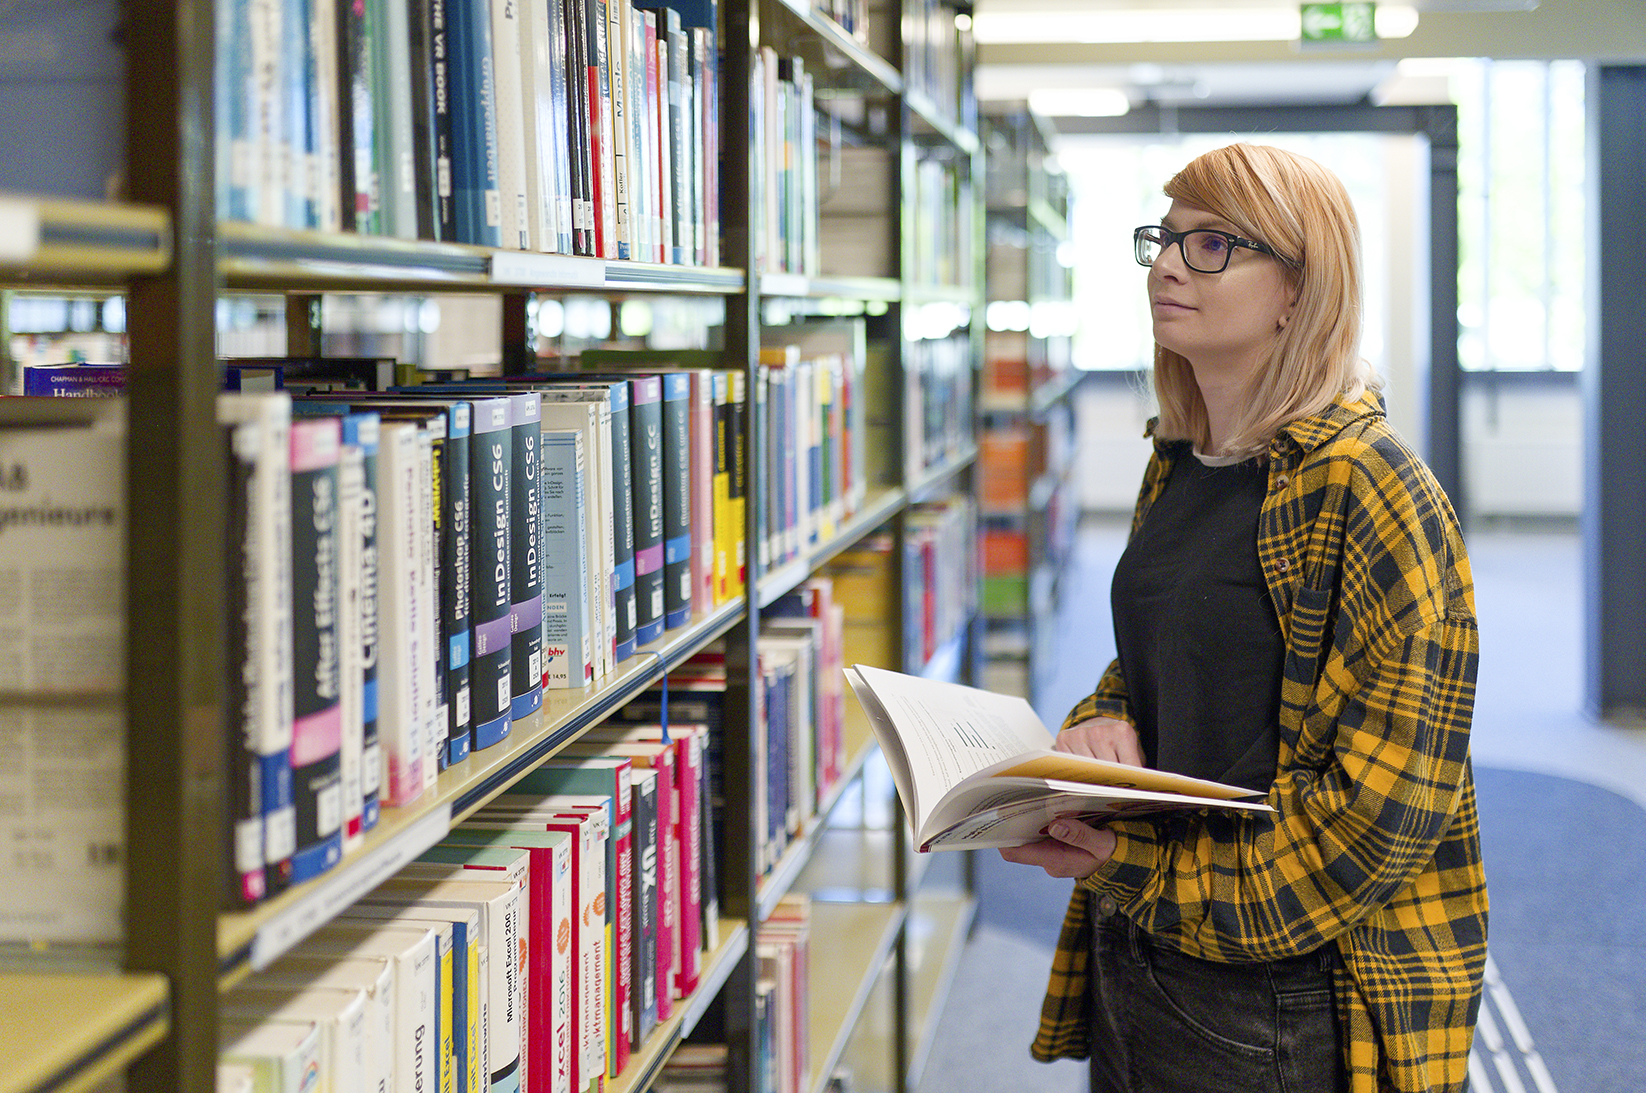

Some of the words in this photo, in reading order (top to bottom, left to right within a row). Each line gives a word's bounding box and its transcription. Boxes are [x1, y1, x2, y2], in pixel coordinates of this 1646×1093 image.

[434, 33, 446, 59] VR
[435, 61, 447, 115] BOOK
[615, 60, 623, 118] Maple
[480, 55, 496, 181] Gruppenarbeit
[525, 436, 535, 481] CS6
[647, 423, 656, 450] CC
[431, 449, 441, 522] LabVIEW
[492, 444, 503, 491] CS6
[454, 500, 464, 532] CS6
[648, 456, 660, 538] InDesign
[493, 500, 507, 607] InDesign
[525, 489, 538, 588] InDesign
[454, 535, 466, 620] Photoshop
[549, 593, 567, 601] Erfolg!
[548, 647, 566, 657] bhv
[553, 672, 567, 680] 14,95
[642, 843, 657, 893] UX
[505, 936, 513, 967] Excel
[558, 970, 566, 1019] 2016
[592, 939, 602, 1038] ktmanagement
[443, 1035, 451, 1078] Excel
[469, 1021, 477, 1057] Excel
[556, 1022, 566, 1081] xcel
